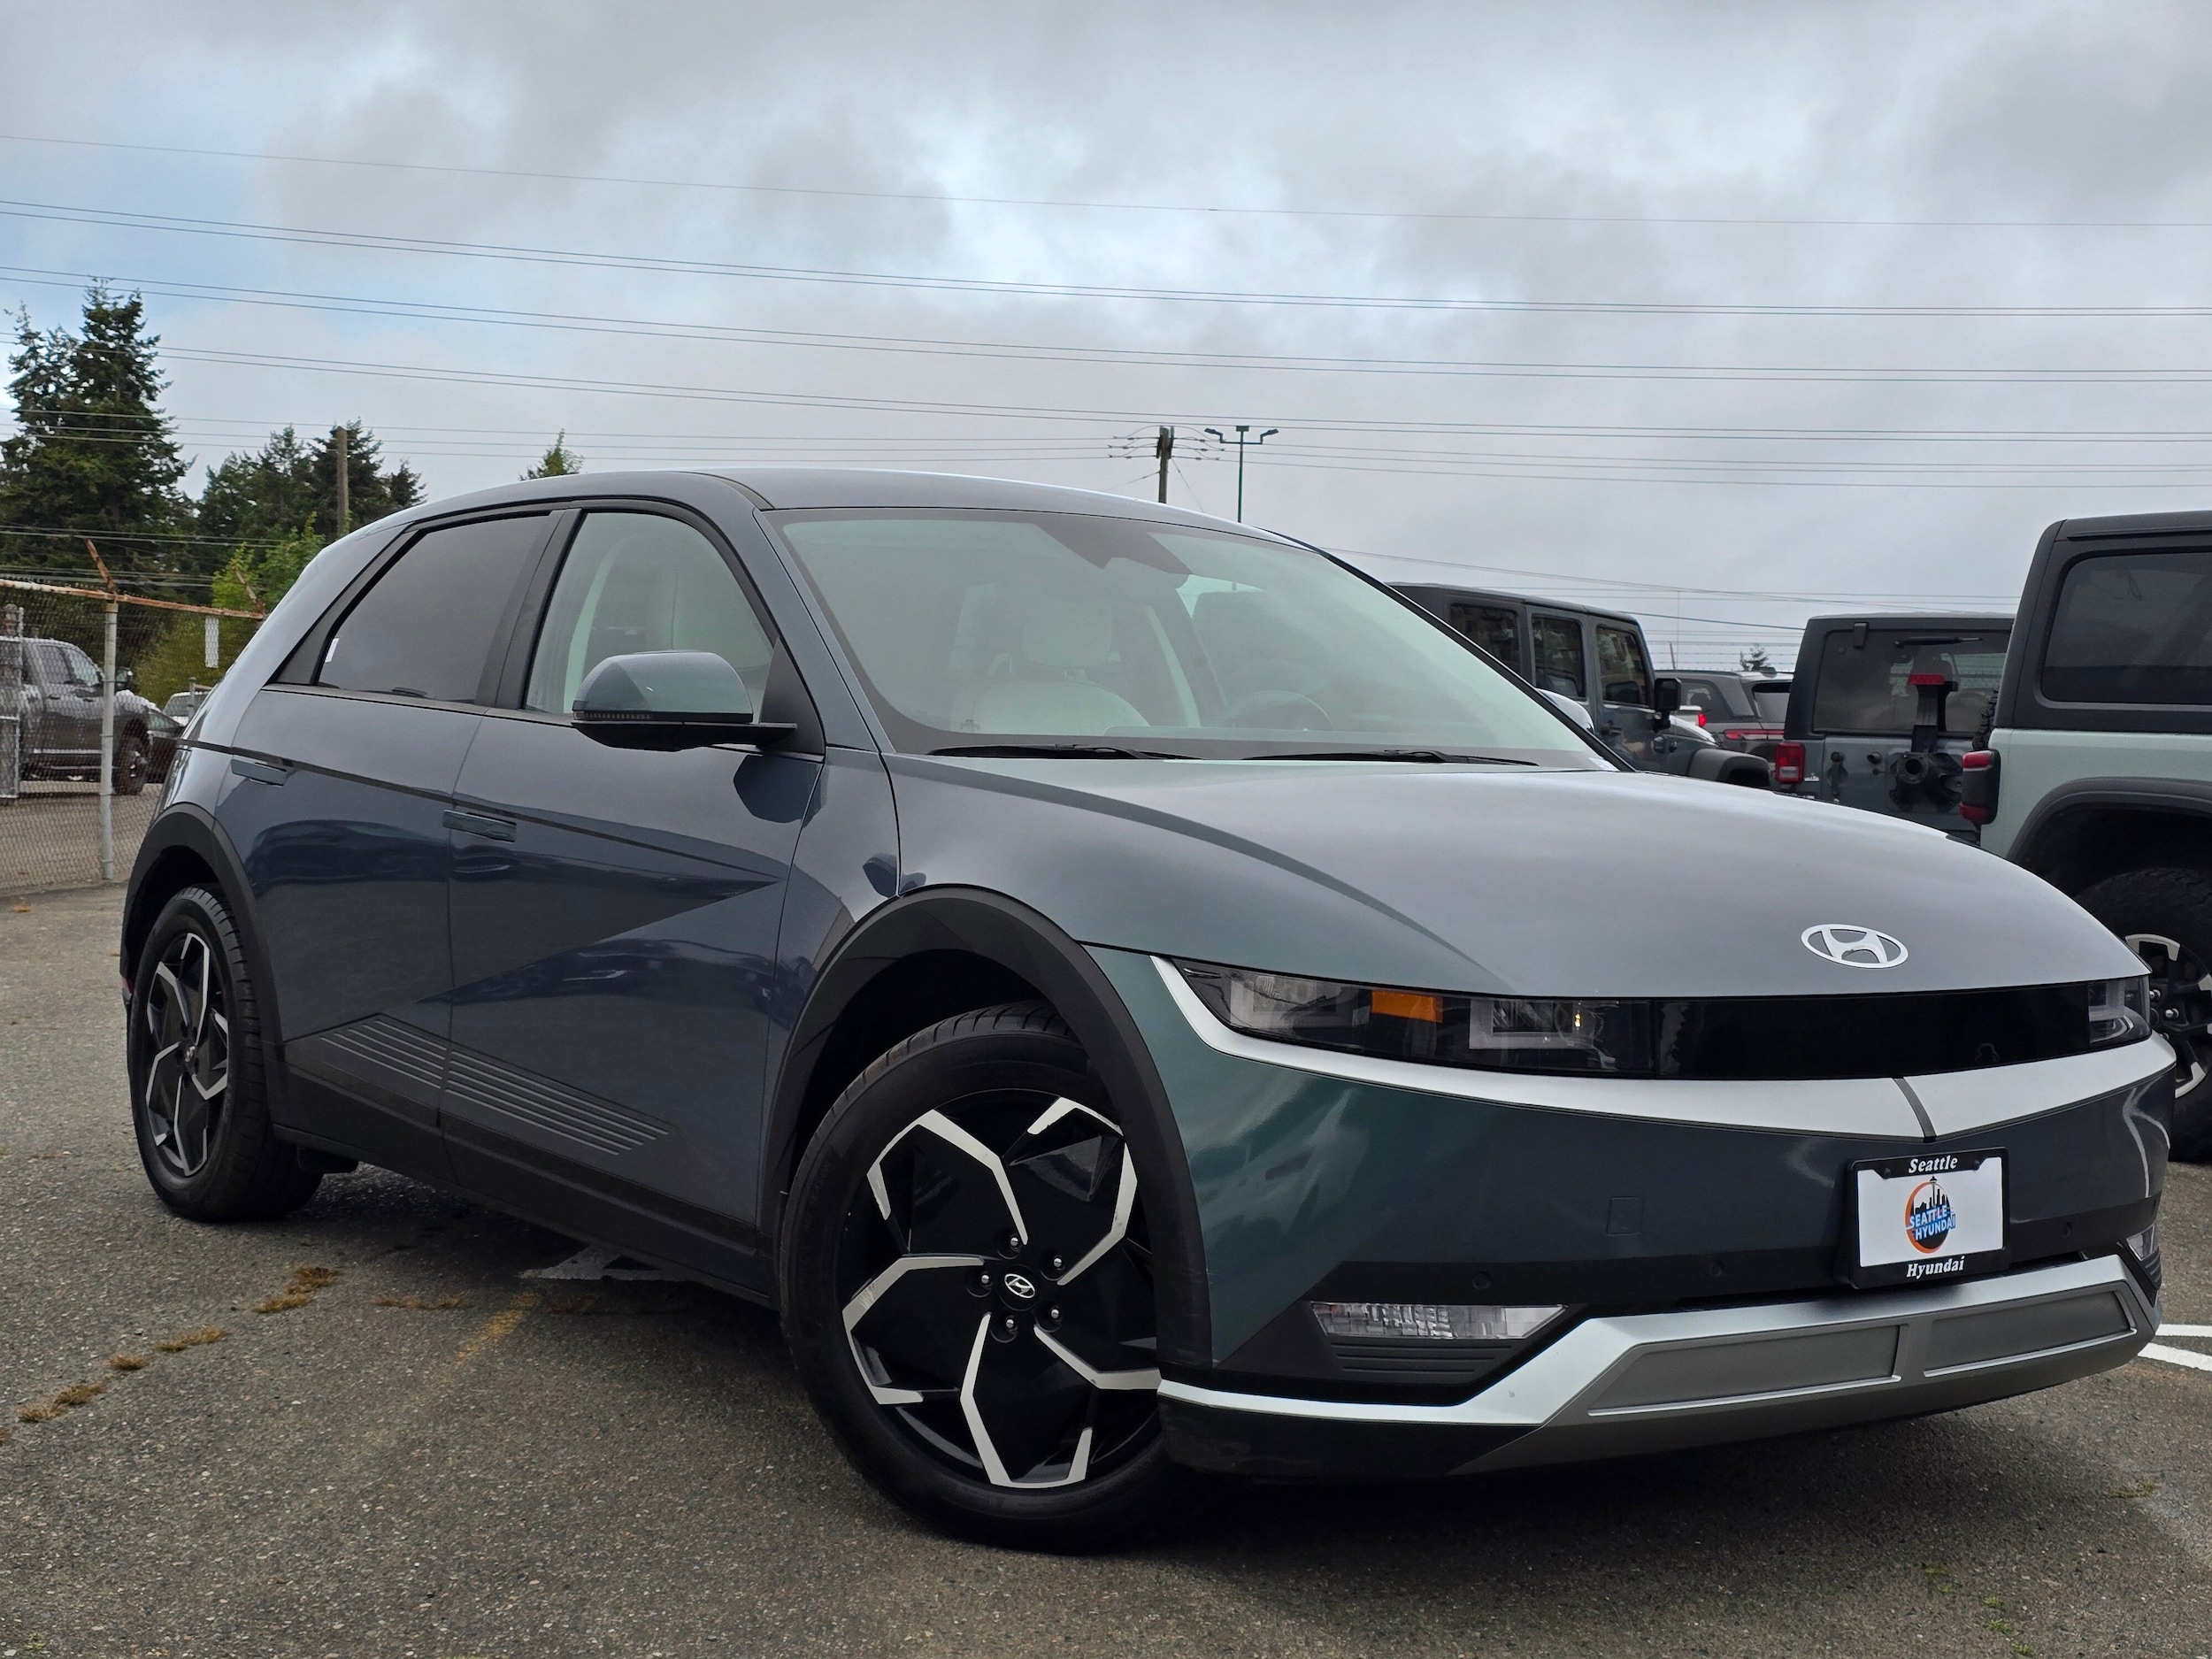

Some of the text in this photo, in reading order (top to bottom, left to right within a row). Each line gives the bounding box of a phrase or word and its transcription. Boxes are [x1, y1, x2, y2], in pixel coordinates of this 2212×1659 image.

[1908, 1154, 1958, 1174] Seattle
[1909, 1204, 1947, 1228] SEATTLE
[1915, 1213, 1956, 1240] HYUNDAI
[1906, 1255, 1965, 1280] Hyundai
